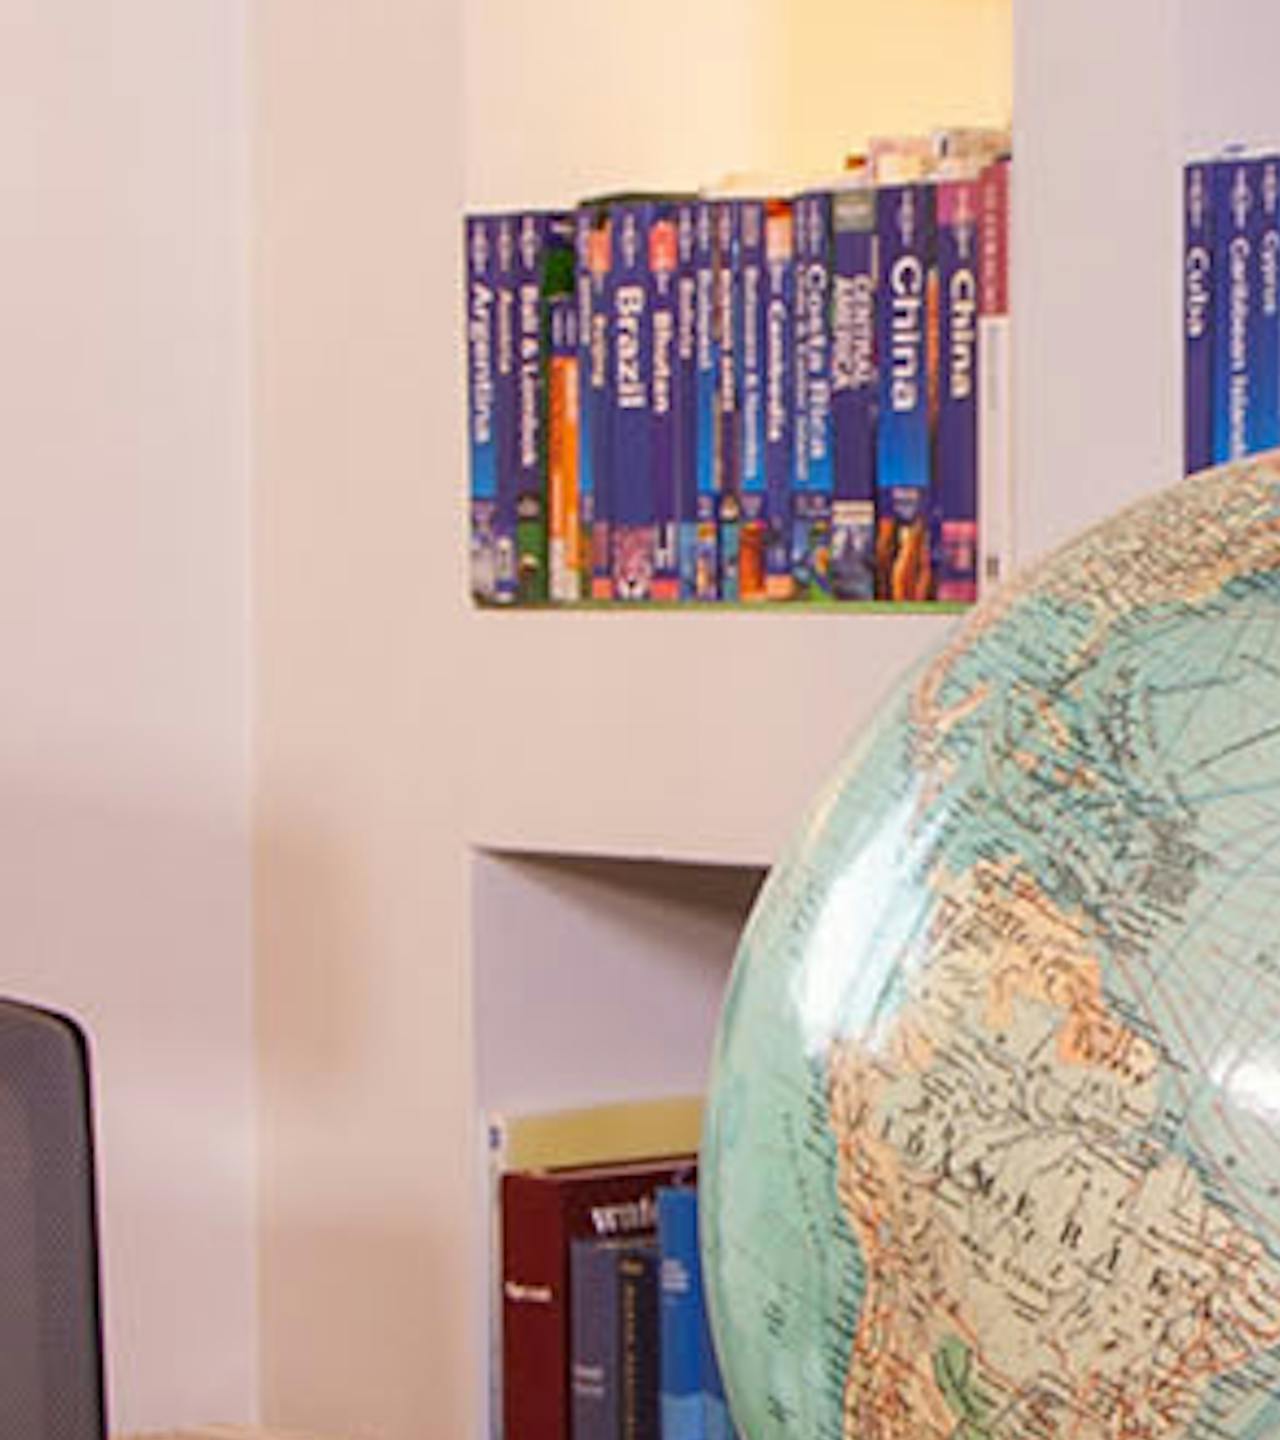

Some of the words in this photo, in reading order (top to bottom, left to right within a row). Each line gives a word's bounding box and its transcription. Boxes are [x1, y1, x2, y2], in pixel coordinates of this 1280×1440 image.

[616, 285, 644, 409] Brazil
[807, 263, 827, 373] Costa
[891, 255, 922, 412] China
[949, 268, 975, 400] China
[1187, 246, 1211, 338] Cuba
[471, 283, 495, 443] Argentina
[808, 381, 830, 459] Rica
